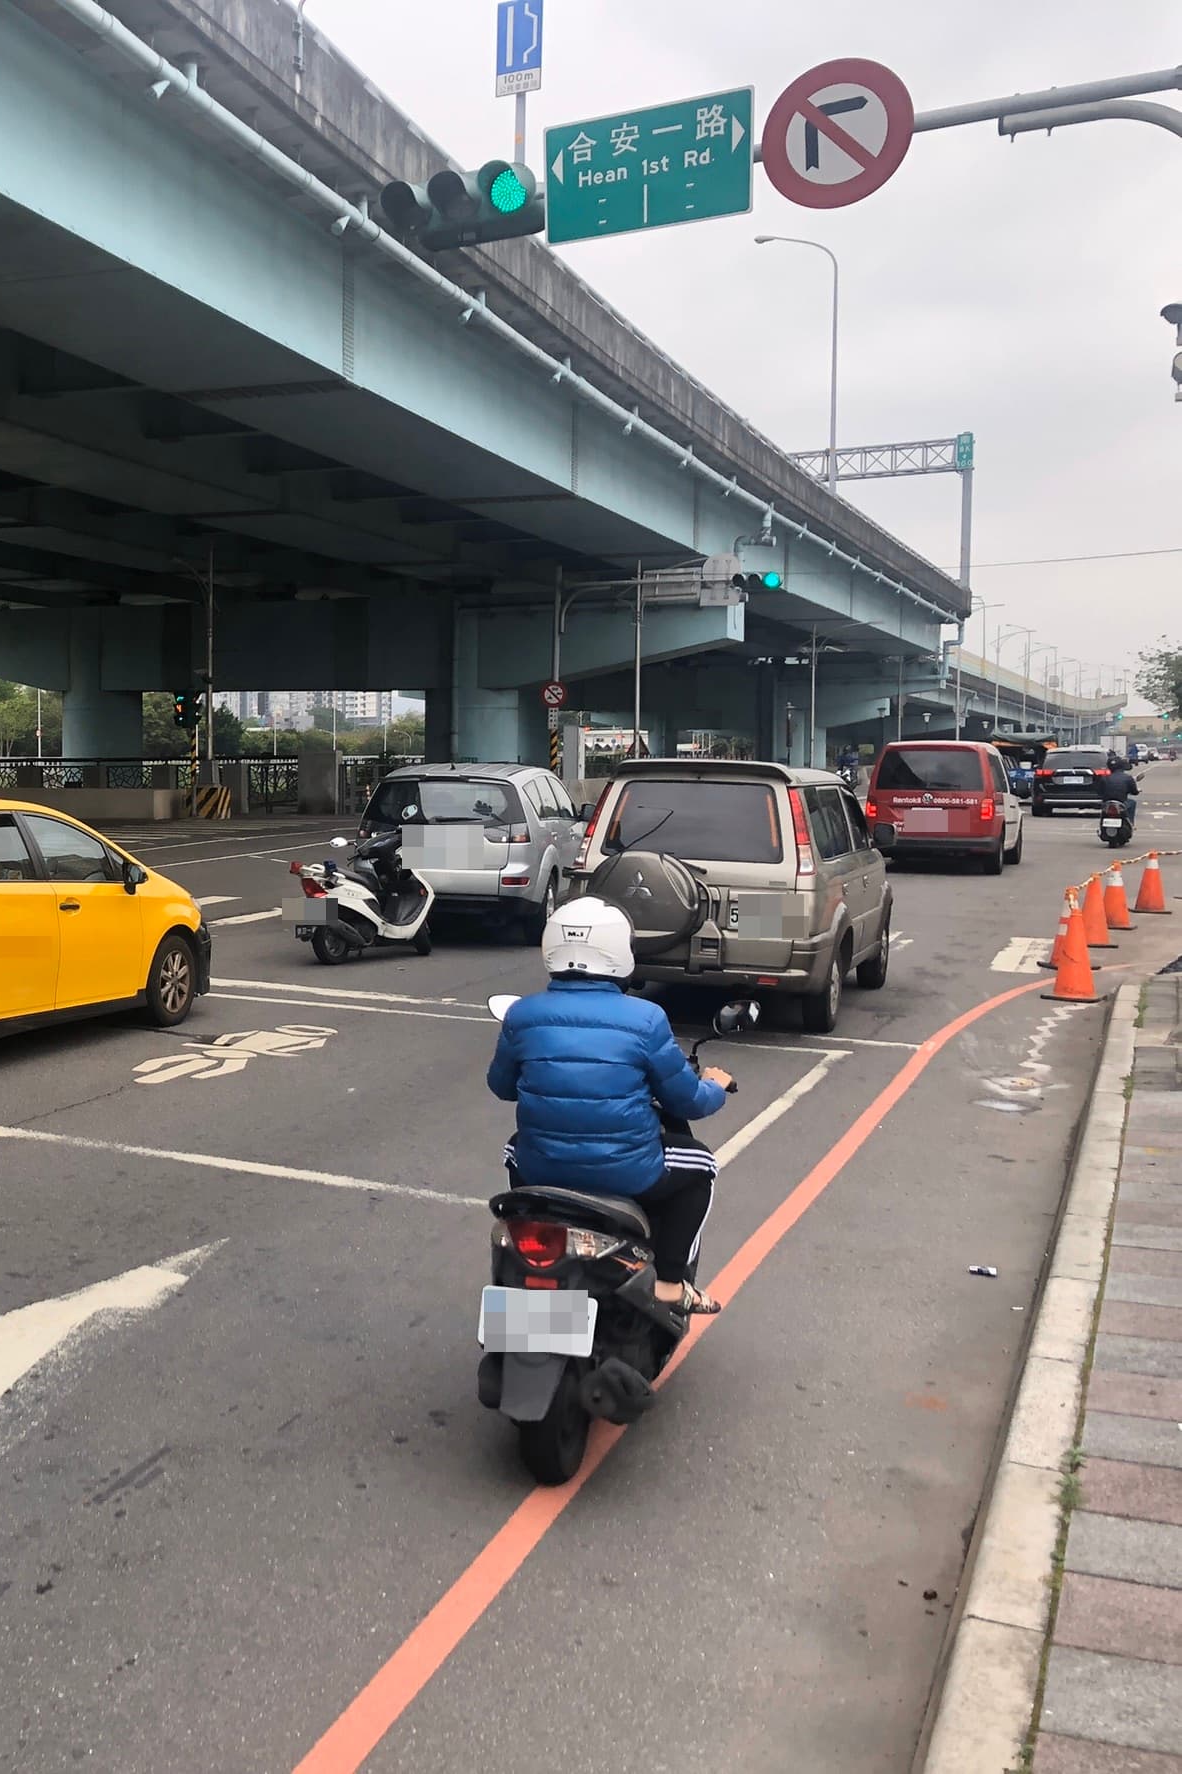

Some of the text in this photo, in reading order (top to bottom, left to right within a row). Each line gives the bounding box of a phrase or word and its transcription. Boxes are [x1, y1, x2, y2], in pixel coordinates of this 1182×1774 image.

[504, 72, 534, 84] 100m
[567, 103, 728, 165] 合安一路
[578, 147, 715, 188] Hean 1st Rd.
